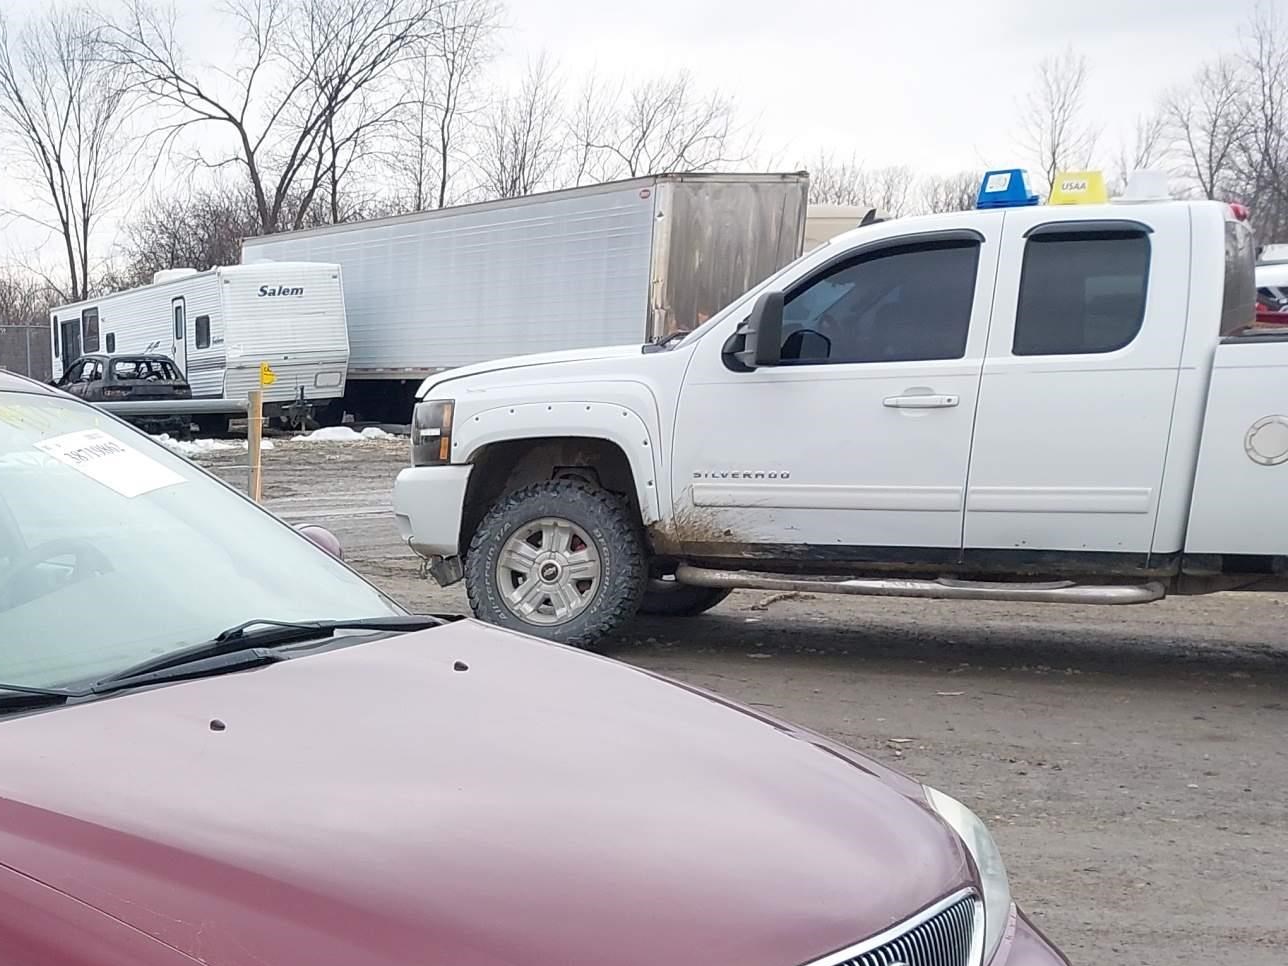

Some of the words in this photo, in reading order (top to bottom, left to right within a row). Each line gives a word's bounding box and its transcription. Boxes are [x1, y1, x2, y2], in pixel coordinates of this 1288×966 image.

[1061, 181, 1087, 192] USAA
[257, 284, 305, 298] Salem
[692, 471, 791, 480] SILVERADO
